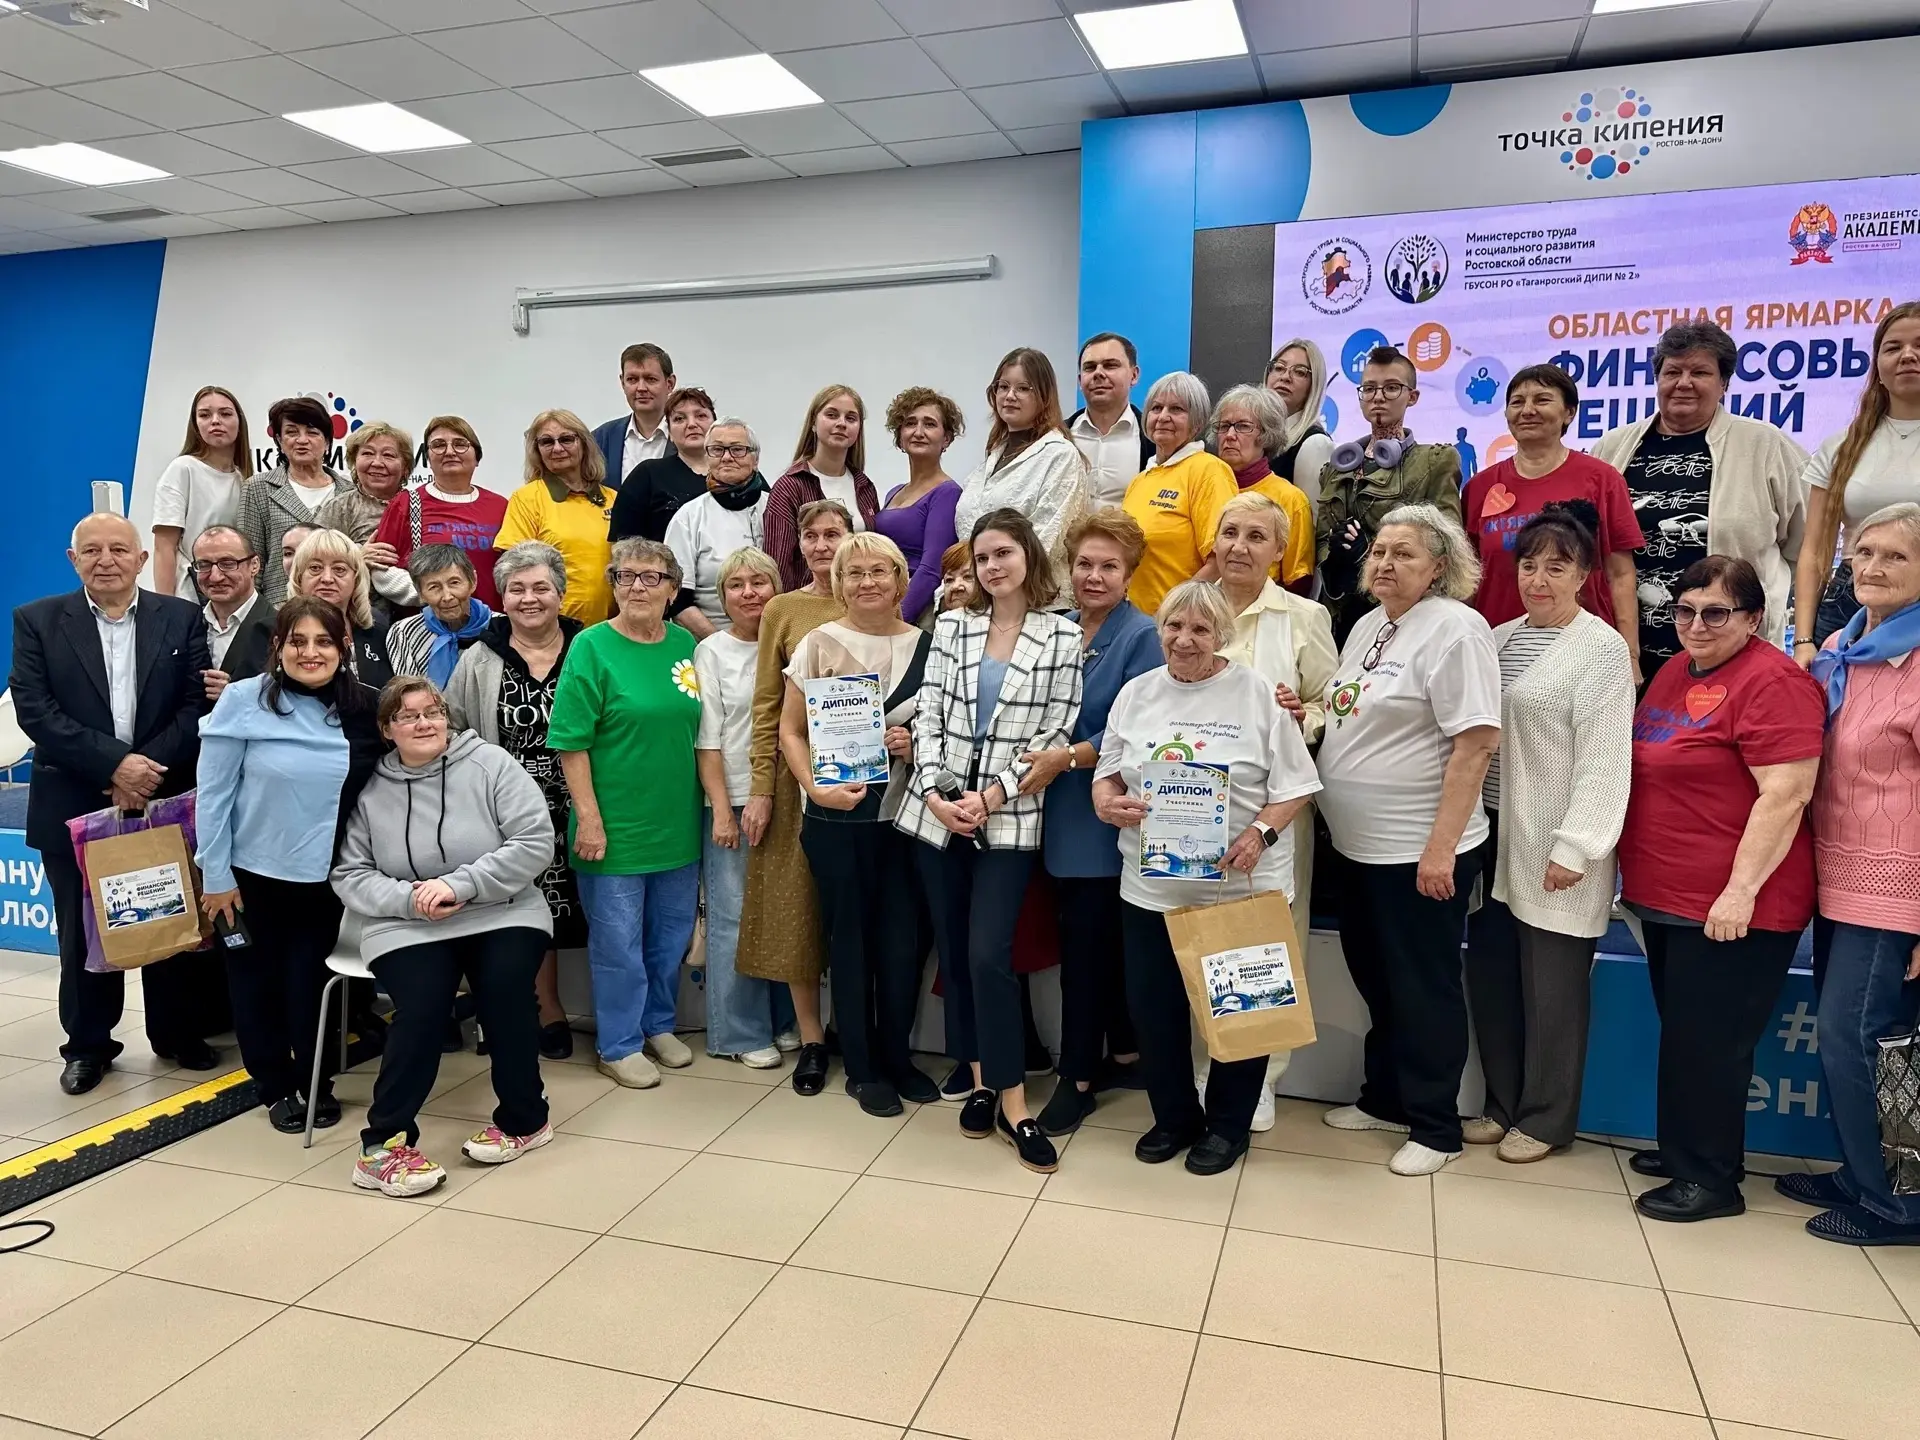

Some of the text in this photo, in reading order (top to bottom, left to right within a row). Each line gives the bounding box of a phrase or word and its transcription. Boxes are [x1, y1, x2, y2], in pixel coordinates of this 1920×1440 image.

[1656, 136, 1722, 148] РОСТОВ-НА-ДОНУ
[1844, 209, 1920, 222] ПРЕЗИДЕНТС
[1466, 227, 1577, 244] Министерство труда
[1843, 219, 1920, 238] АКАДЕМ
[1465, 239, 1596, 257] и социального развития
[1465, 254, 1572, 271] Ростовской области
[1464, 279, 1498, 291] ГБУСОН
[1500, 279, 1514, 288] РО
[1515, 275, 1582, 288] «Таганрогский
[1583, 272, 1613, 284] ДИПИ
[821, 696, 869, 711] ДИПЛОМ
[1157, 785, 1213, 797] ДИПЛОМ
[136, 887, 166, 897] РЕШЕНИЙ
[1238, 962, 1284, 973] ФИНАНСОВЫХ
[1239, 970, 1273, 979] РЕШЕНИЙ
